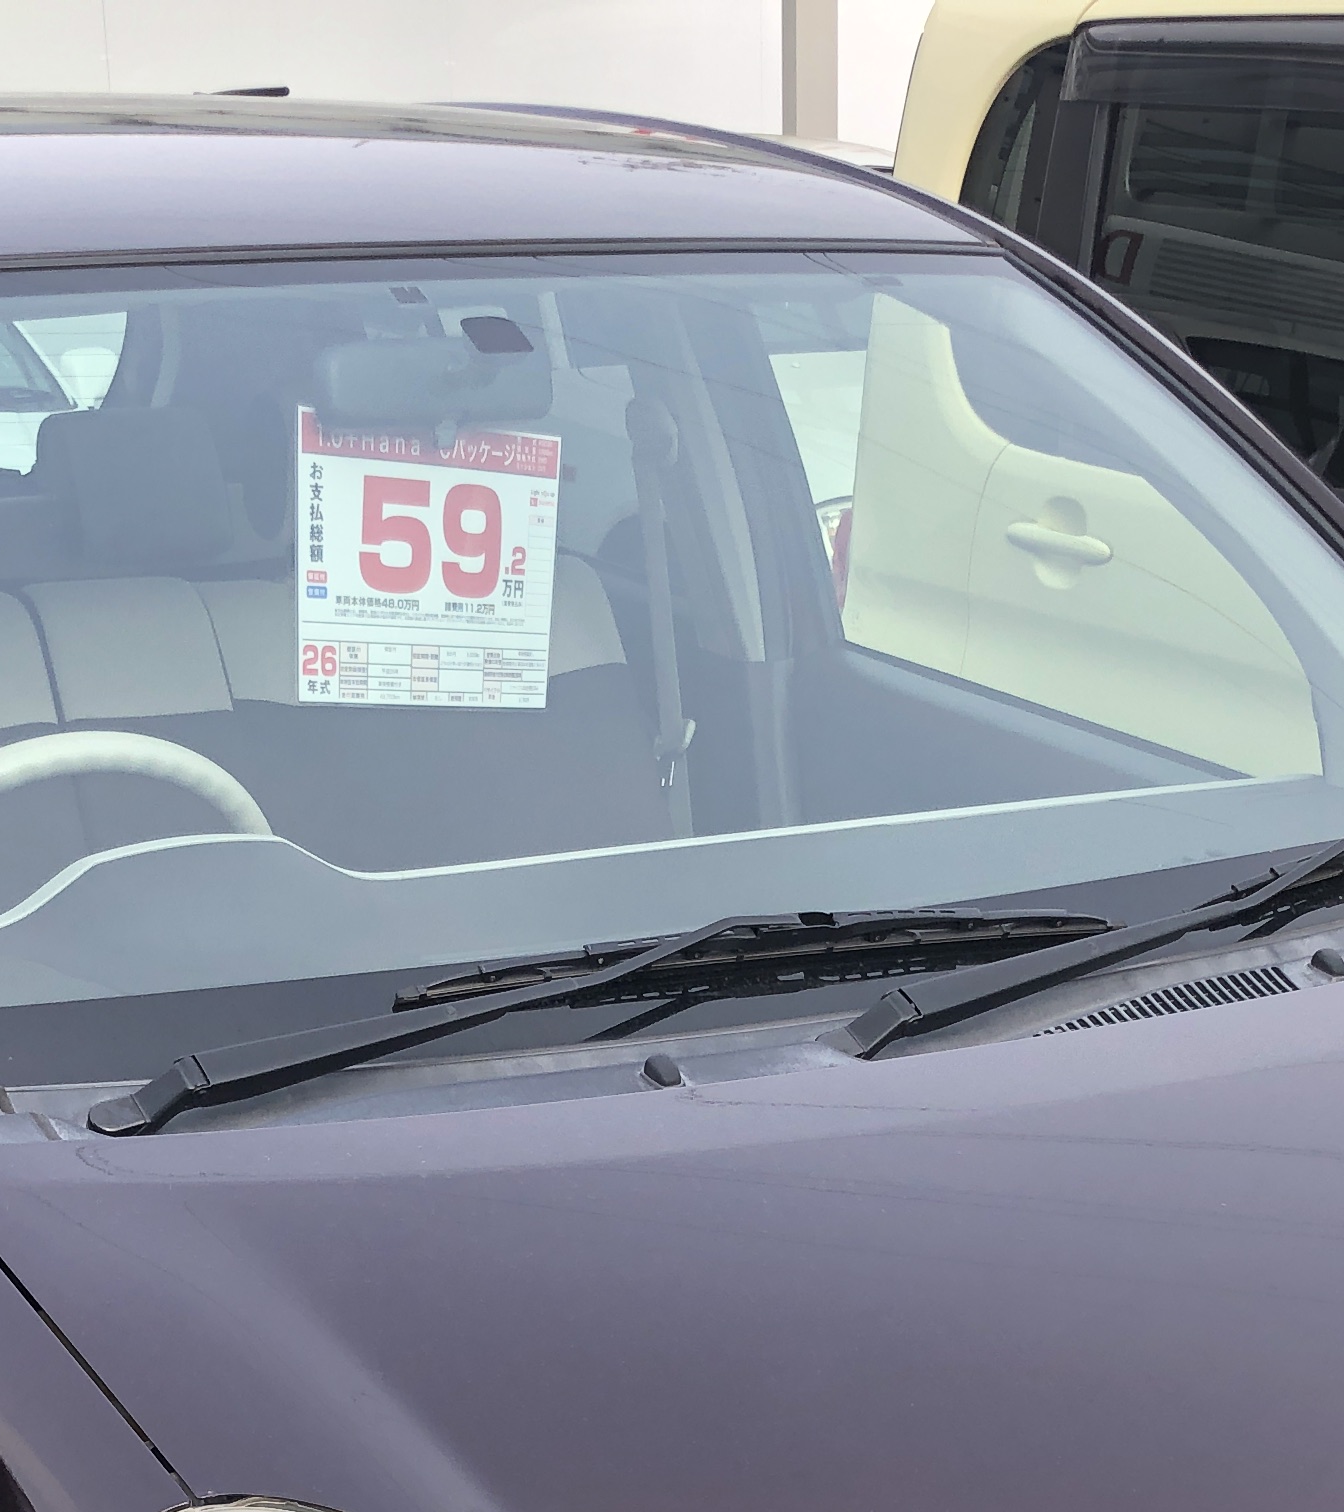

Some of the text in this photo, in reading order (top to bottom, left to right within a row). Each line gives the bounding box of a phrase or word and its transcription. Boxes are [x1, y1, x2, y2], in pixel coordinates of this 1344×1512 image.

[309, 461, 324, 563] お支払総額
[502, 579, 524, 599] 万円
[302, 644, 337, 677] 26
[307, 679, 331, 695] 年式
